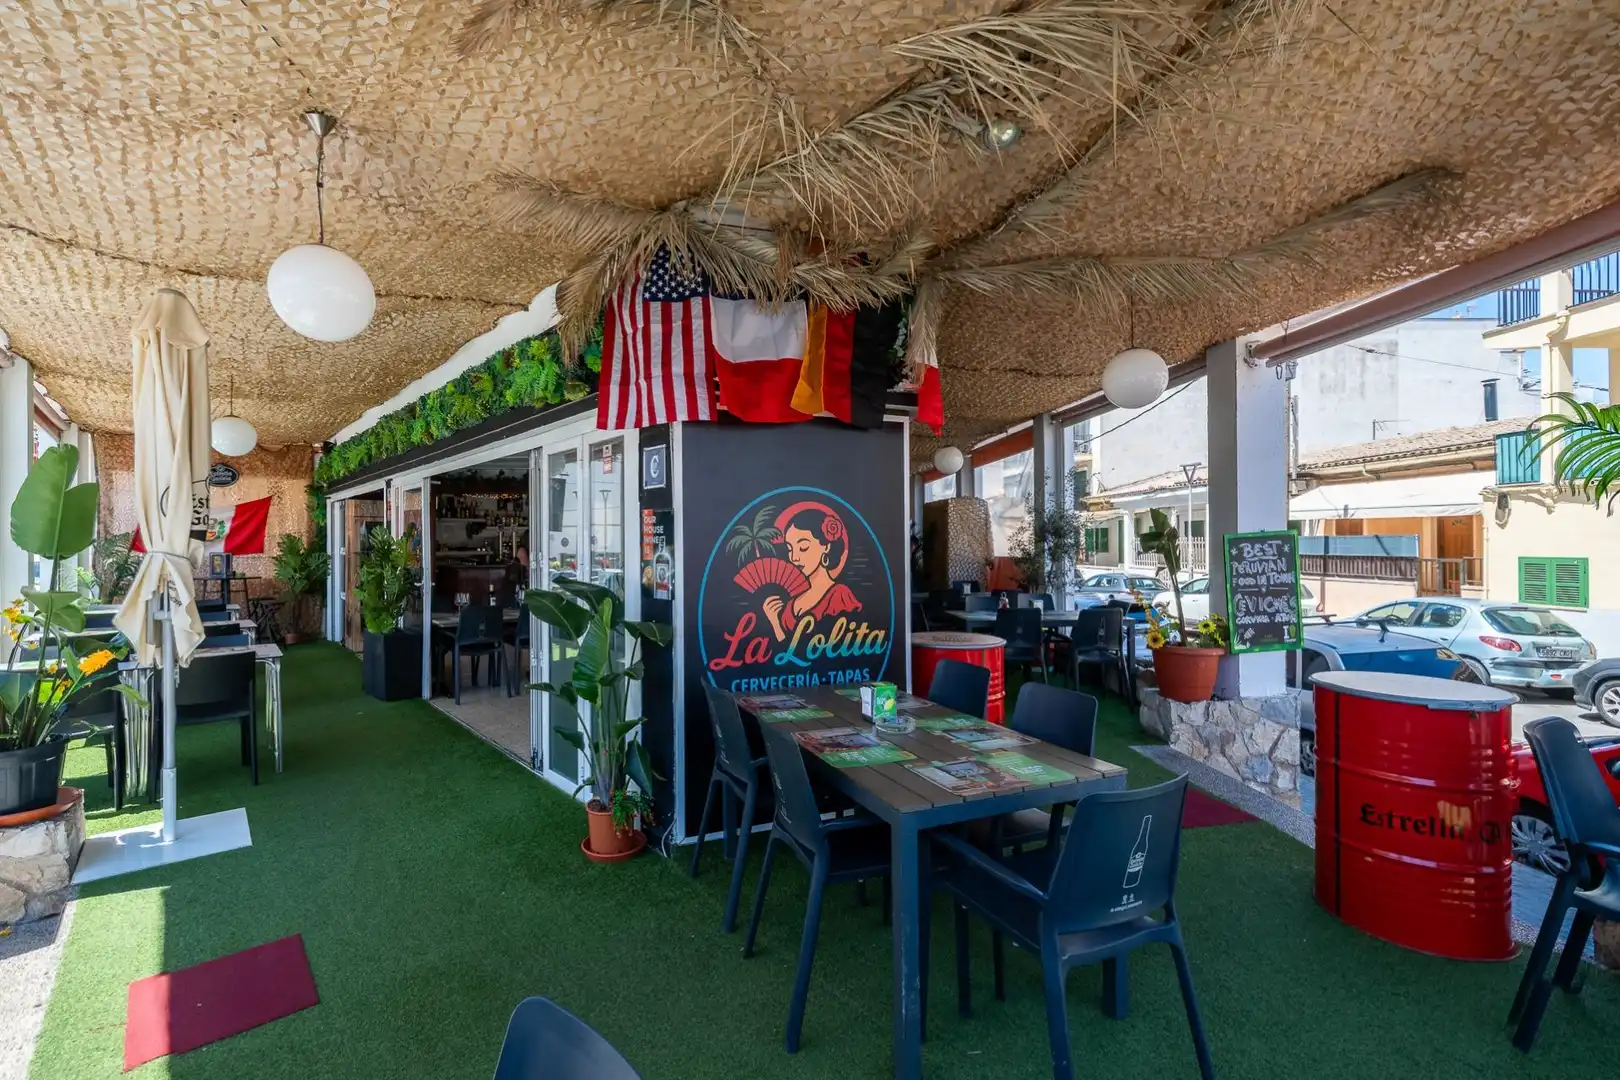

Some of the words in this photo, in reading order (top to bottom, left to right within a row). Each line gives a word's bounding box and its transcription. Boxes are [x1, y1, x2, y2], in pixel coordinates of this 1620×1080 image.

[643, 515, 657, 524] OUR
[643, 525, 665, 534] HOUSE
[1240, 540, 1282, 558] BEST
[1231, 558, 1287, 576] PERUVIAN
[1232, 576, 1256, 587] FOOD
[1257, 575, 1267, 586] IN
[1267, 571, 1295, 585] TOWN
[709, 612, 772, 671] La
[774, 616, 888, 667] Lolita
[731, 670, 820, 694] CERVECERÍA
[828, 668, 870, 685] TAPAS
[1359, 802, 1466, 841] Estrella
